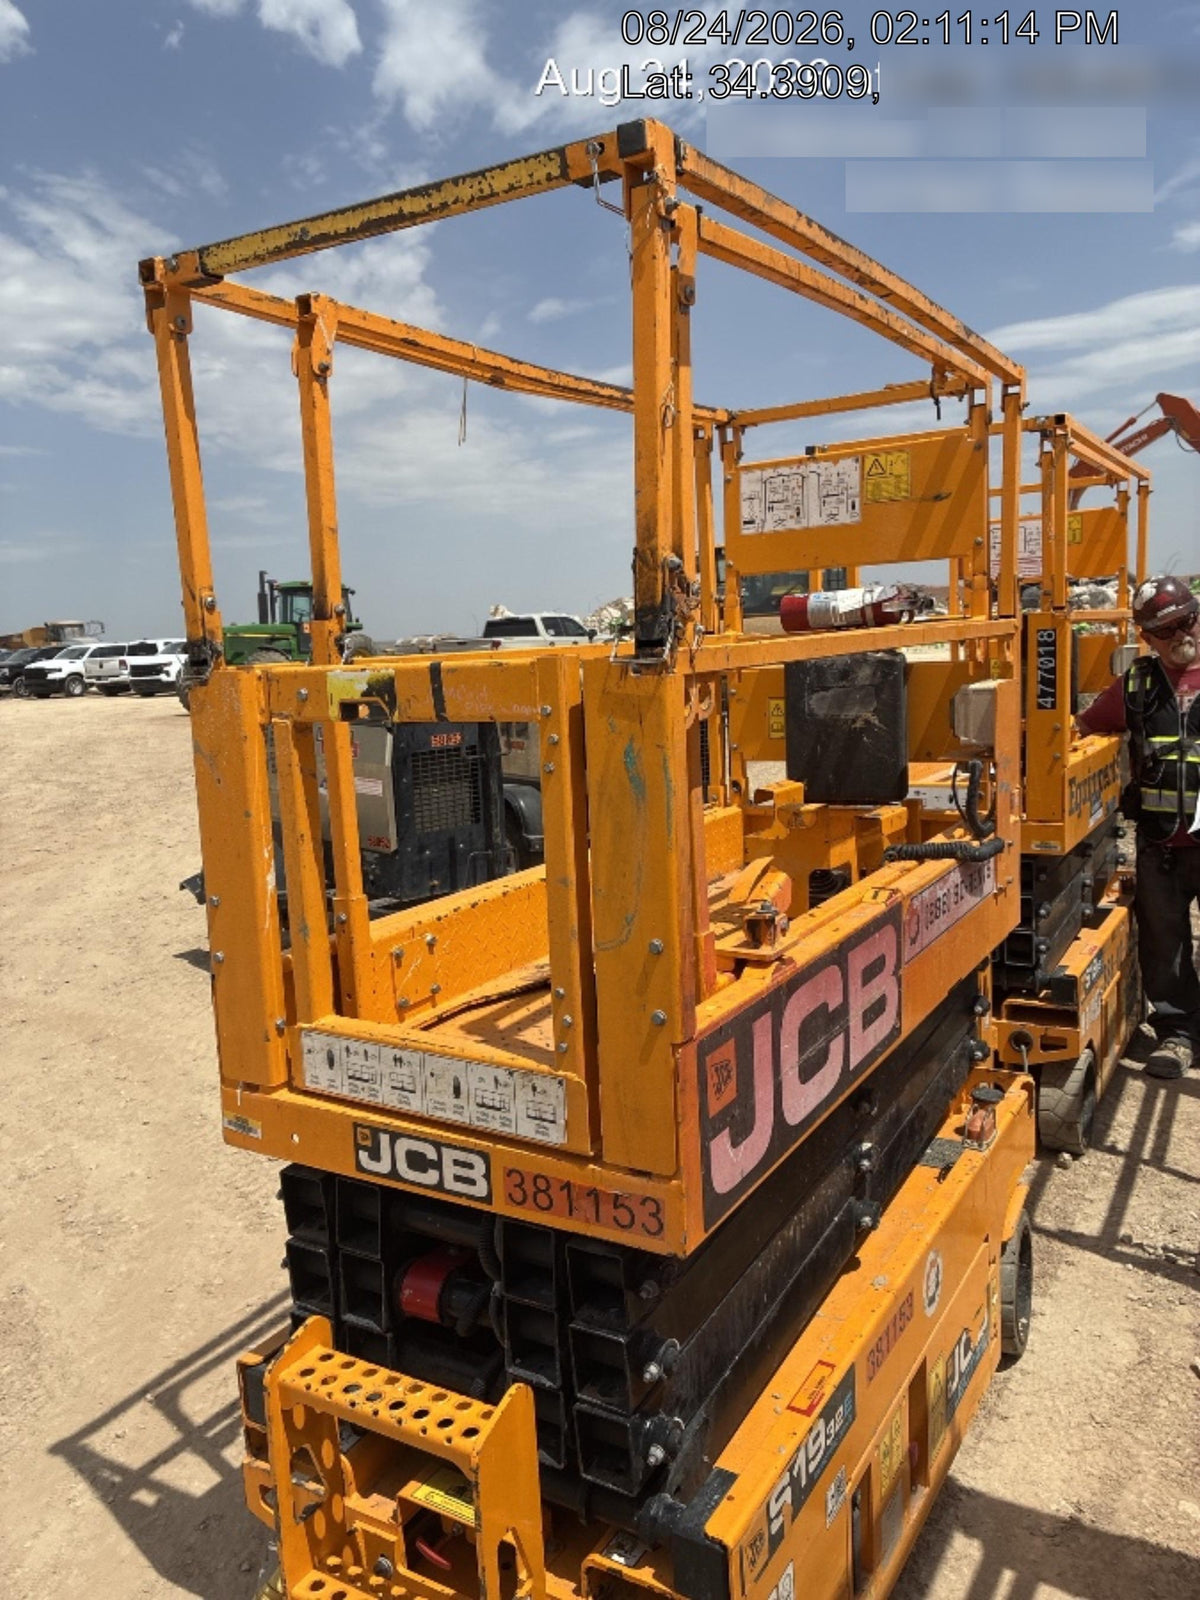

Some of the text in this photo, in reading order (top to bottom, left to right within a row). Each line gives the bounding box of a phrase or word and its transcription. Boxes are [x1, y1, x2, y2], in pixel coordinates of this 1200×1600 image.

[1037, 630, 1056, 709] 477018
[710, 923, 900, 1195] JCB
[358, 1131, 665, 1237] JCB 381153
[867, 1290, 914, 1383] 381153
